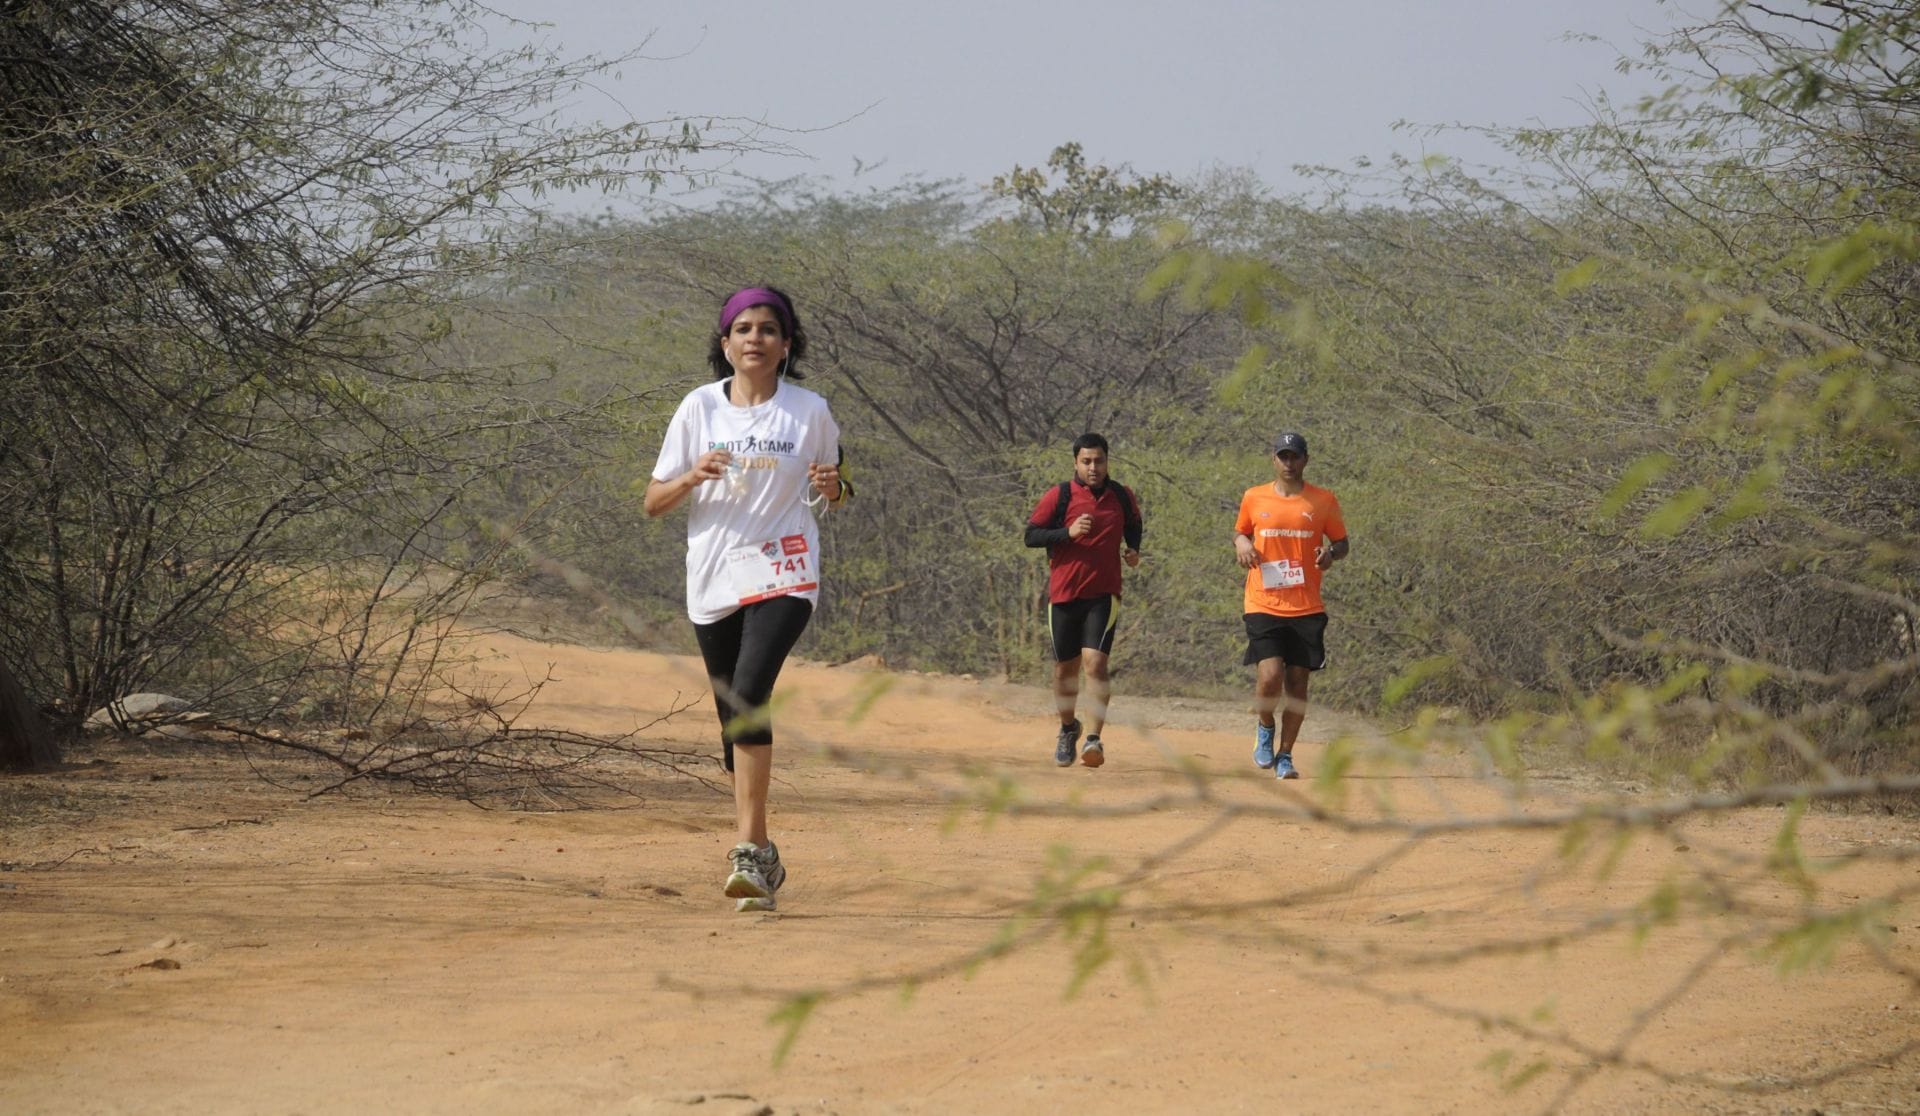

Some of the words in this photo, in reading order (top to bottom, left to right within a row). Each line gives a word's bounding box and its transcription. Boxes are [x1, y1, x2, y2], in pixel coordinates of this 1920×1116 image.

[708, 440, 743, 453] OT
[758, 440, 794, 454] CAMP
[770, 556, 806, 575] 741
[1282, 569, 1301, 579] 704
